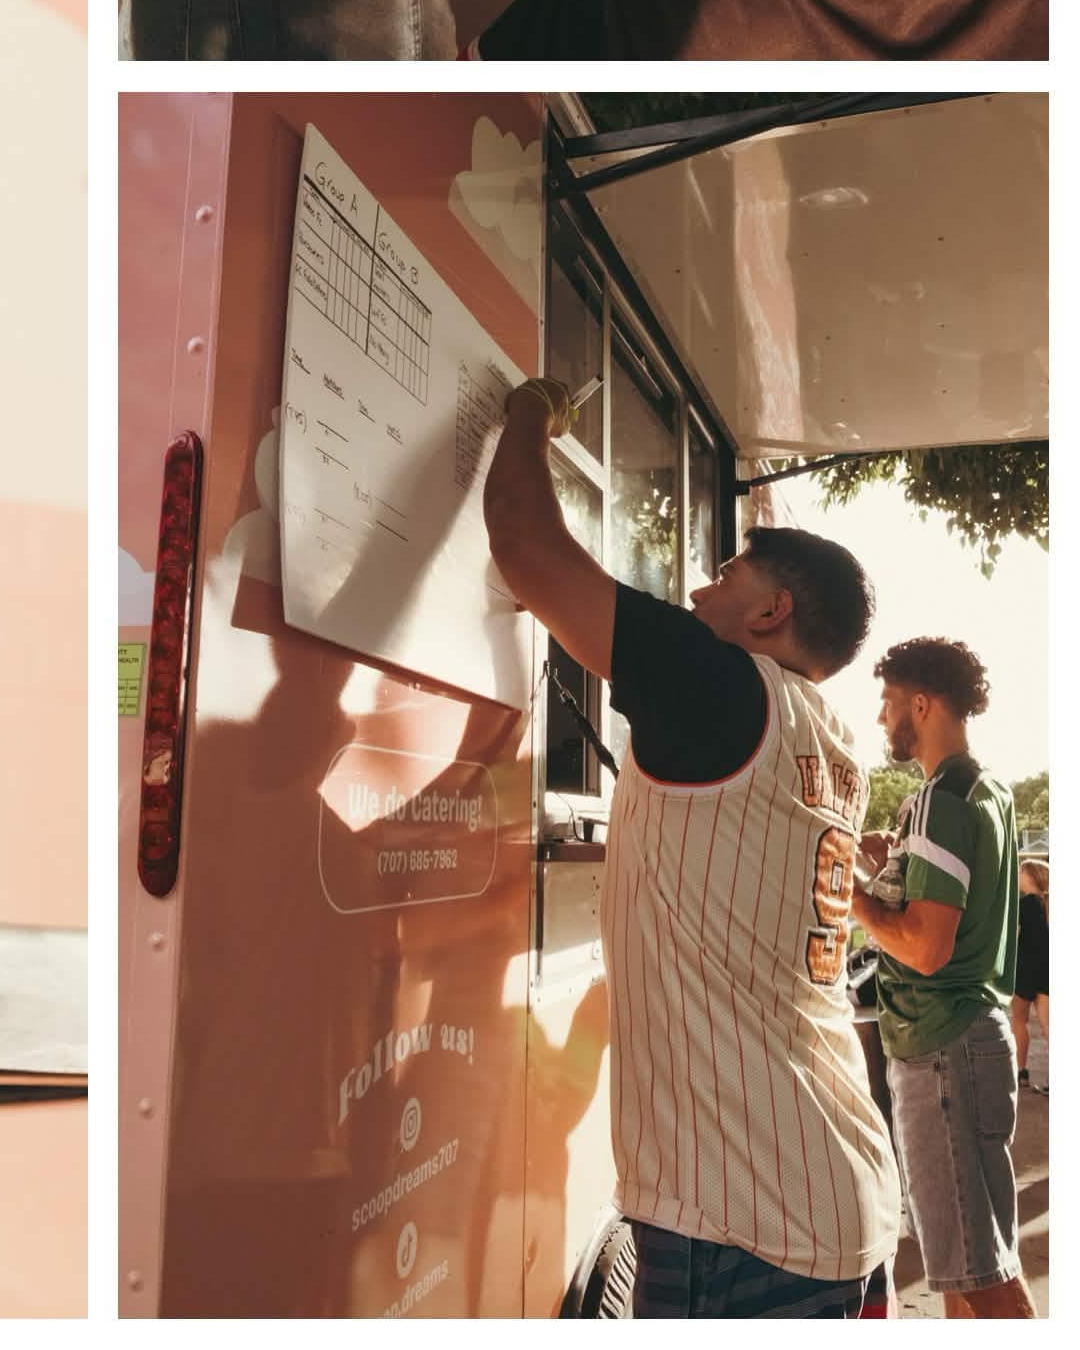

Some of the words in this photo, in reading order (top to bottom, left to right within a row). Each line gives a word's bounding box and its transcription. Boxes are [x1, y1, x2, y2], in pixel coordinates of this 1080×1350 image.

[315, 161, 345, 207] Group
[350, 193, 358, 218] A
[378, 235, 406, 275] Group
[410, 265, 419, 284] B
[346, 783, 378, 821] We
[383, 786, 407, 821] do
[411, 790, 483, 833] Catering!
[377, 851, 408, 875] (707)
[338, 1023, 433, 1127] Follow
[439, 1023, 475, 1067] us!
[351, 1137, 460, 1233] scoopdreams707
